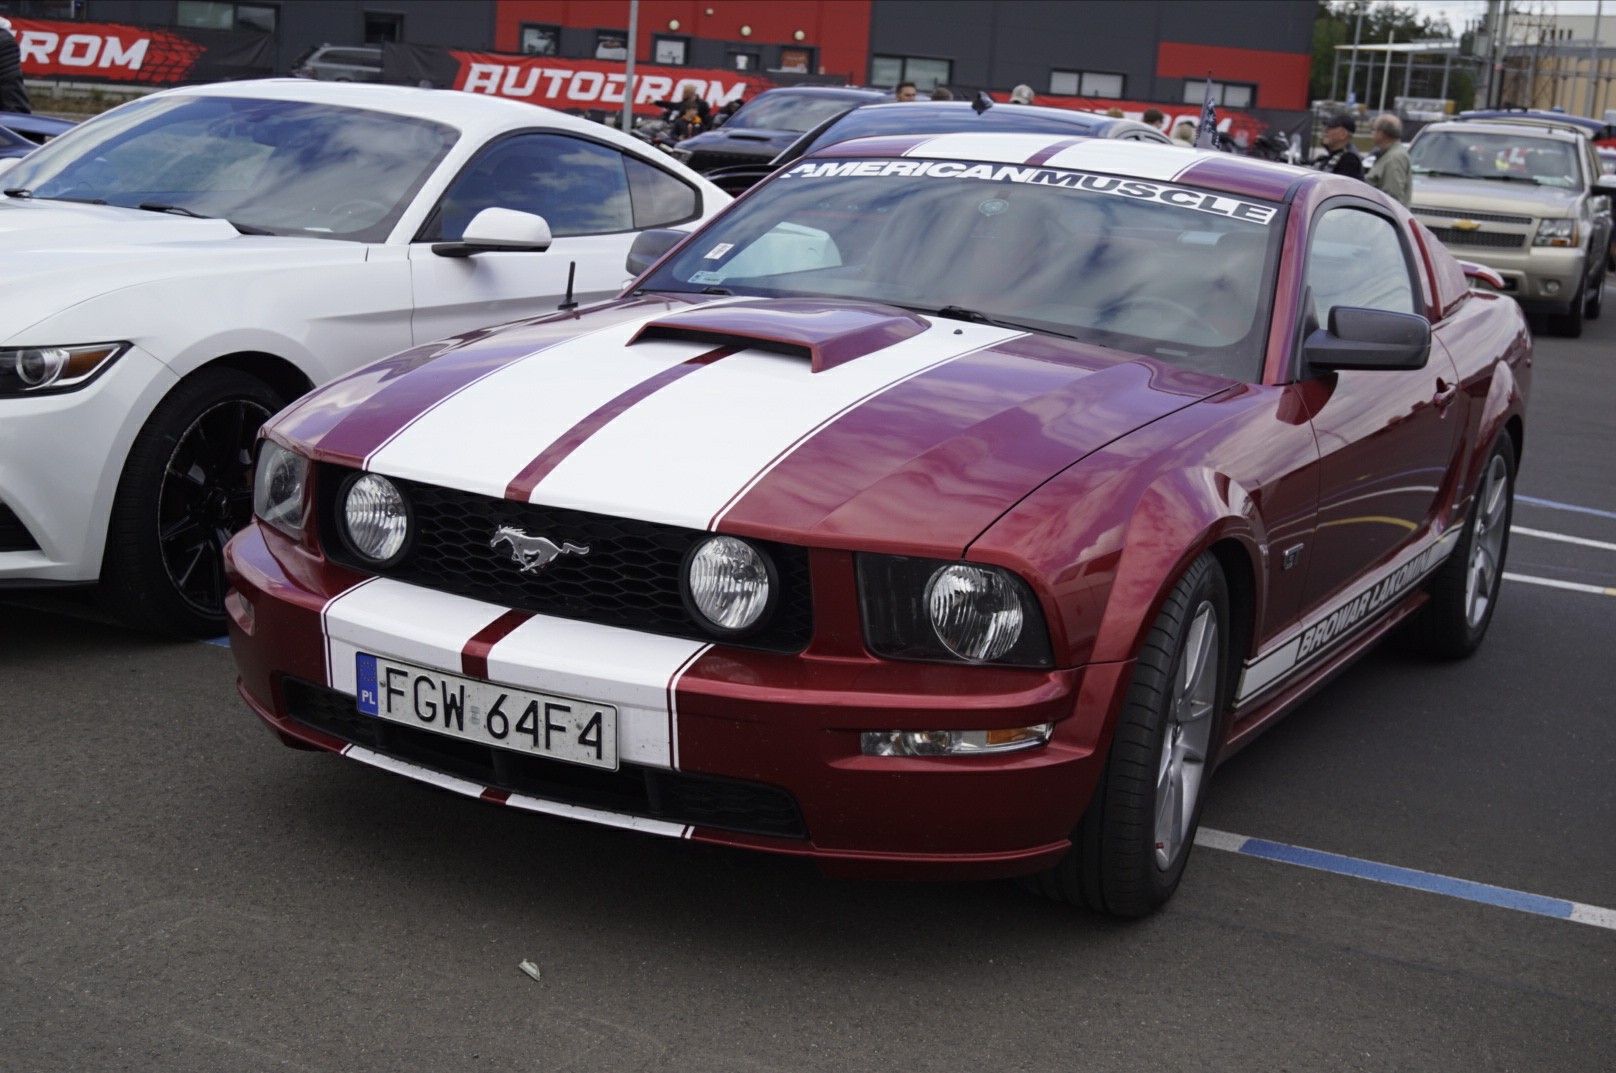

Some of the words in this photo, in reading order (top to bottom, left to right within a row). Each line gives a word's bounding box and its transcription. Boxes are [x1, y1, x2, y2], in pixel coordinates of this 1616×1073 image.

[12, 30, 151, 70] ROM
[463, 62, 748, 107] AUTODROM
[1297, 591, 1371, 661] BROWAR
[361, 690, 376, 705] PL
[386, 666, 465, 732] FGW
[486, 694, 603, 760] 64F4
